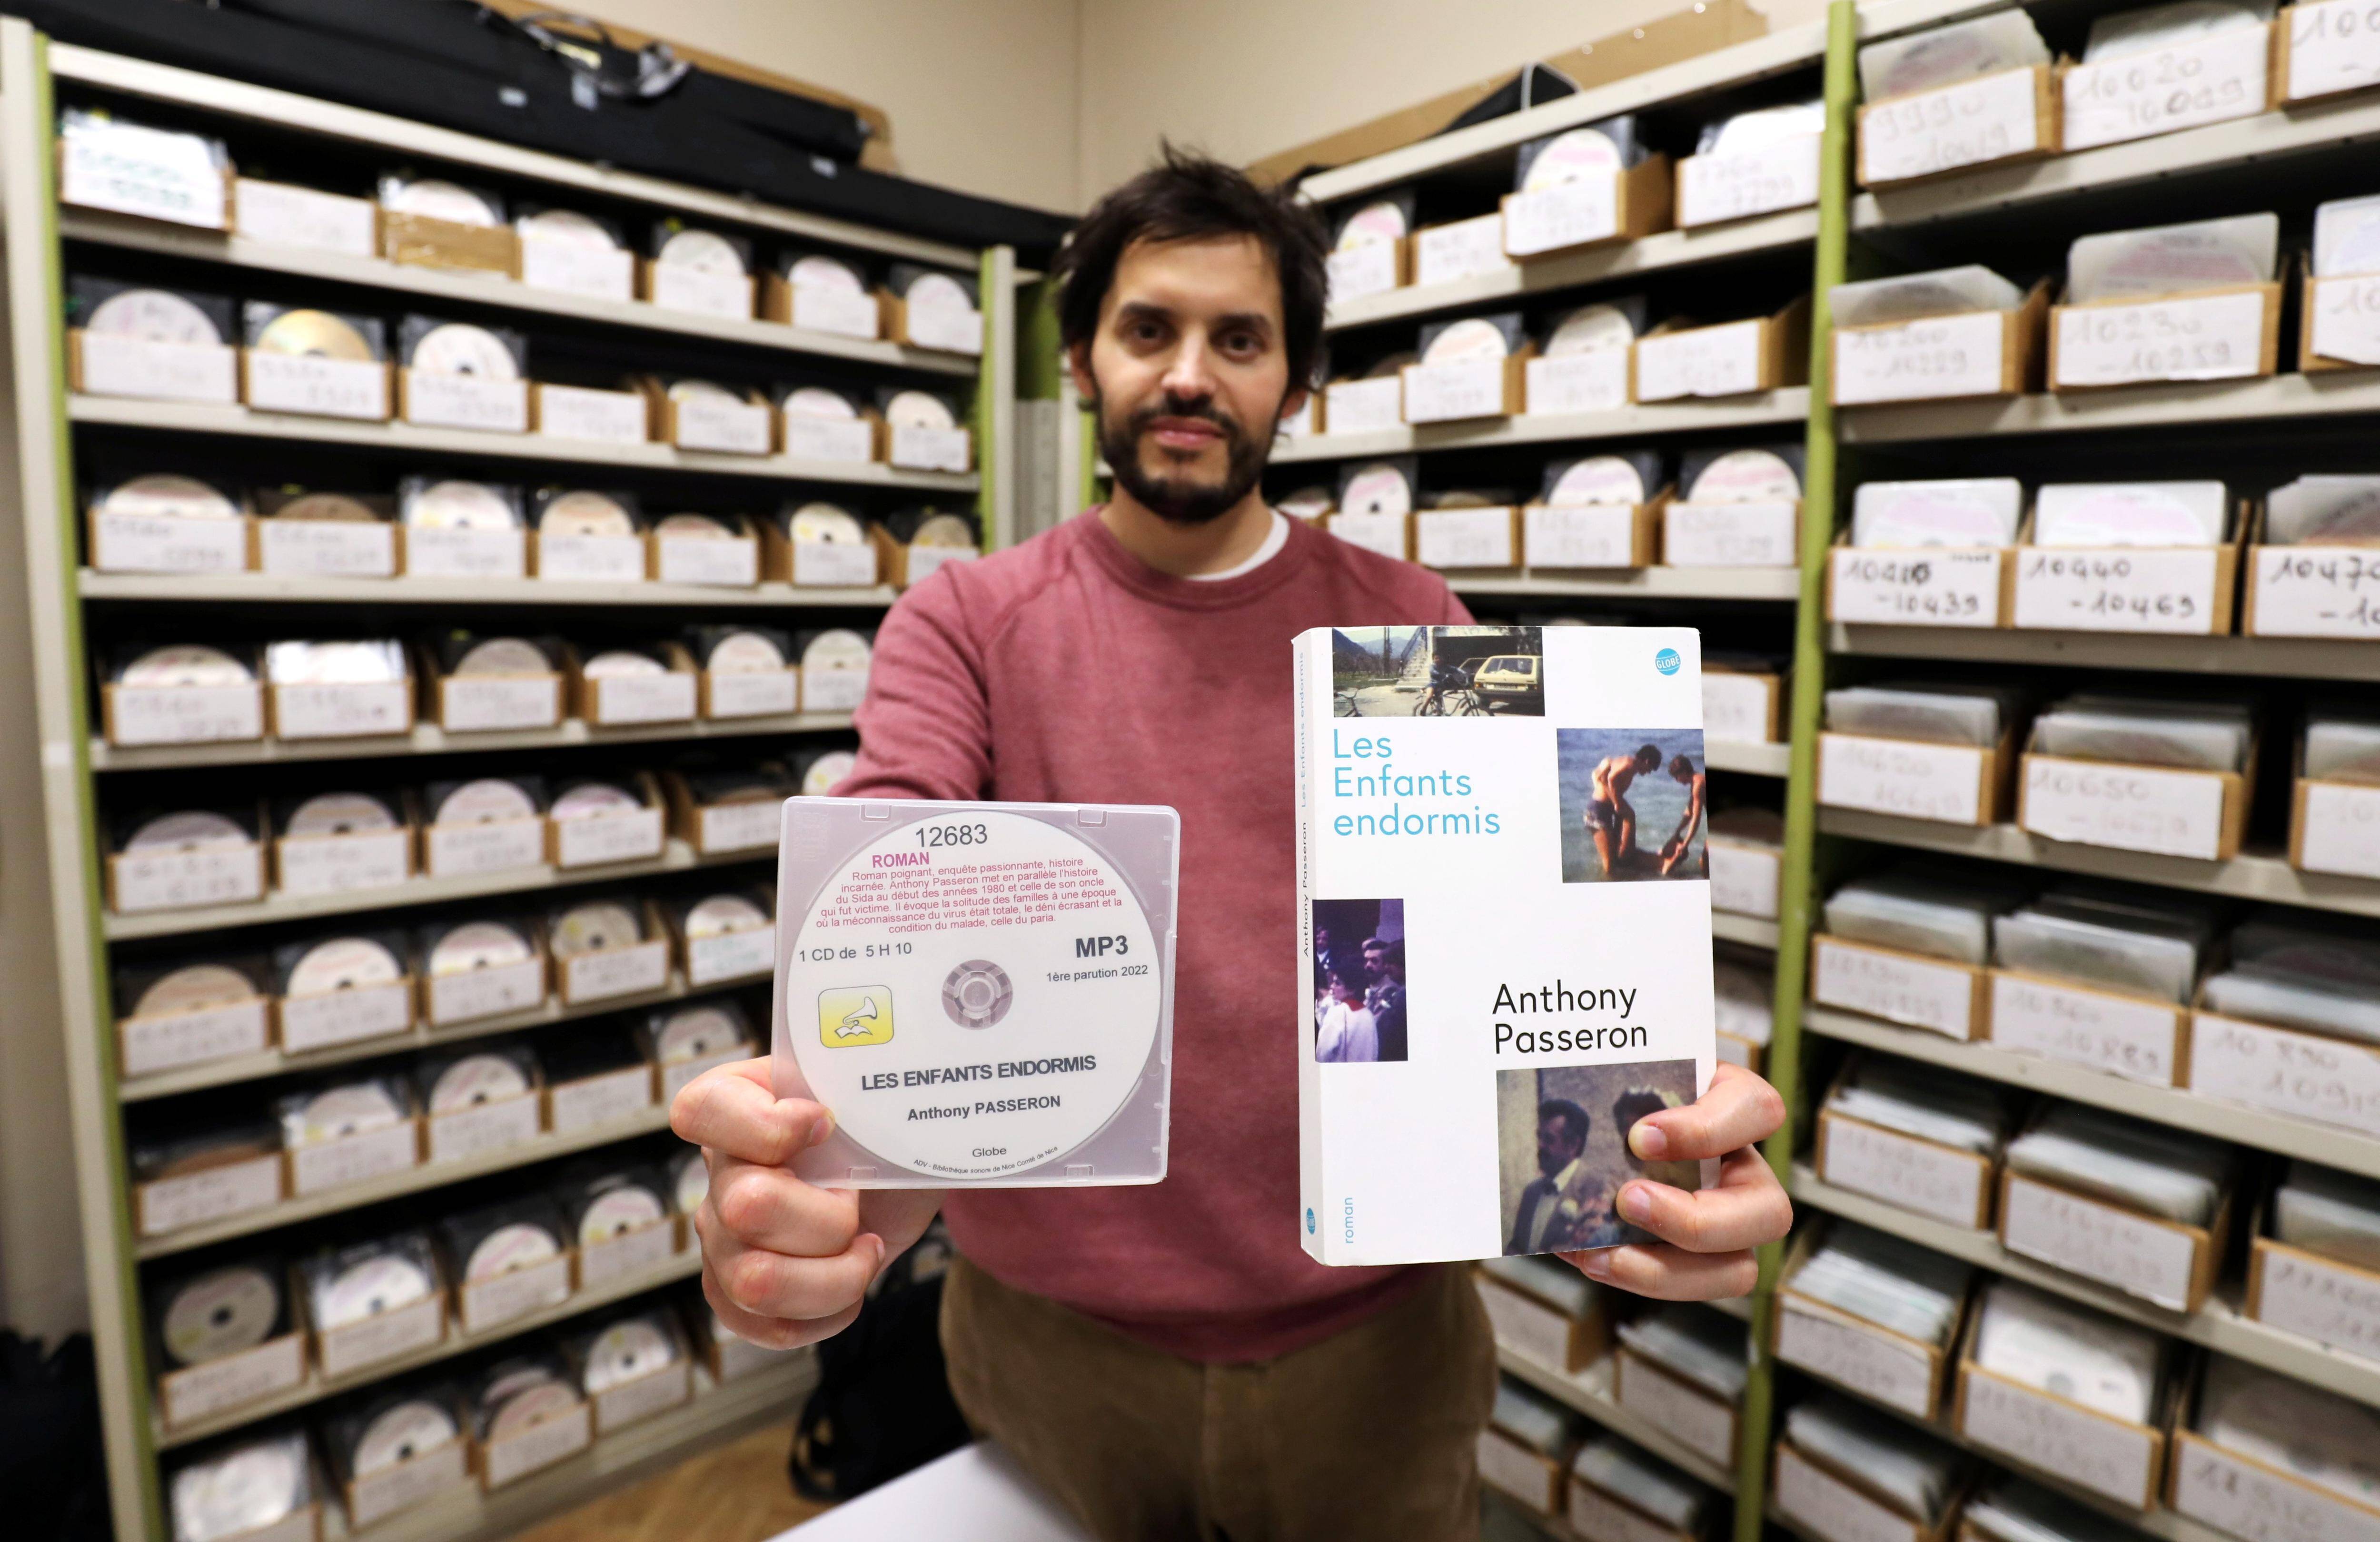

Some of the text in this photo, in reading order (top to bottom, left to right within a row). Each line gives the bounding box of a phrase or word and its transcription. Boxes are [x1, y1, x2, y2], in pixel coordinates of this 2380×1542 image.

[2028, 555, 2131, 582] 10440
[2270, 554, 2380, 591] 10470
[2071, 588, 2195, 620] -10469
[1656, 655, 1680, 669] GLOBE
[1333, 729, 1392, 759] Les
[1335, 763, 1472, 797] Enfants
[1334, 802, 1500, 836] endormis
[915, 824, 988, 848] 12683
[852, 859, 1083, 881] Roman poignant, enquête passionnante, histoire
[872, 851, 930, 869] ROMAN
[835, 877, 1104, 904] du Sida au début des années 1980 et celle de son oncle
[841, 881, 886, 893] incarnée.
[889, 878, 930, 890] Anthony
[932, 877, 979, 887] Passeron
[982, 874, 1000, 883] met
[1017, 870, 1057, 883] parallèle
[1059, 867, 1098, 878] l'histoire
[816, 897, 1122, 928] où la méconnaissance du virus était totale, le déni écrasant et la
[821, 889, 1117, 919] qui fut victime. Il évoque la solitude des familles à une époque
[889, 913, 1056, 934] condition du malade, celle du paria.
[799, 942, 912, 962] 1 CD de 5 H 10
[1075, 935, 1129, 959] MP3
[1047, 965, 1148, 982] 1ère parution 2022
[1492, 979, 1637, 1019] Anthony
[1495, 1022, 1647, 1055] Passeron
[862, 1055, 1097, 1091] LES ENFANTS ENDORMIS
[907, 1095, 1061, 1121] Anthony PASSERON
[972, 1147, 1007, 1157] Globe
[1345, 1197, 1354, 1244] roman
